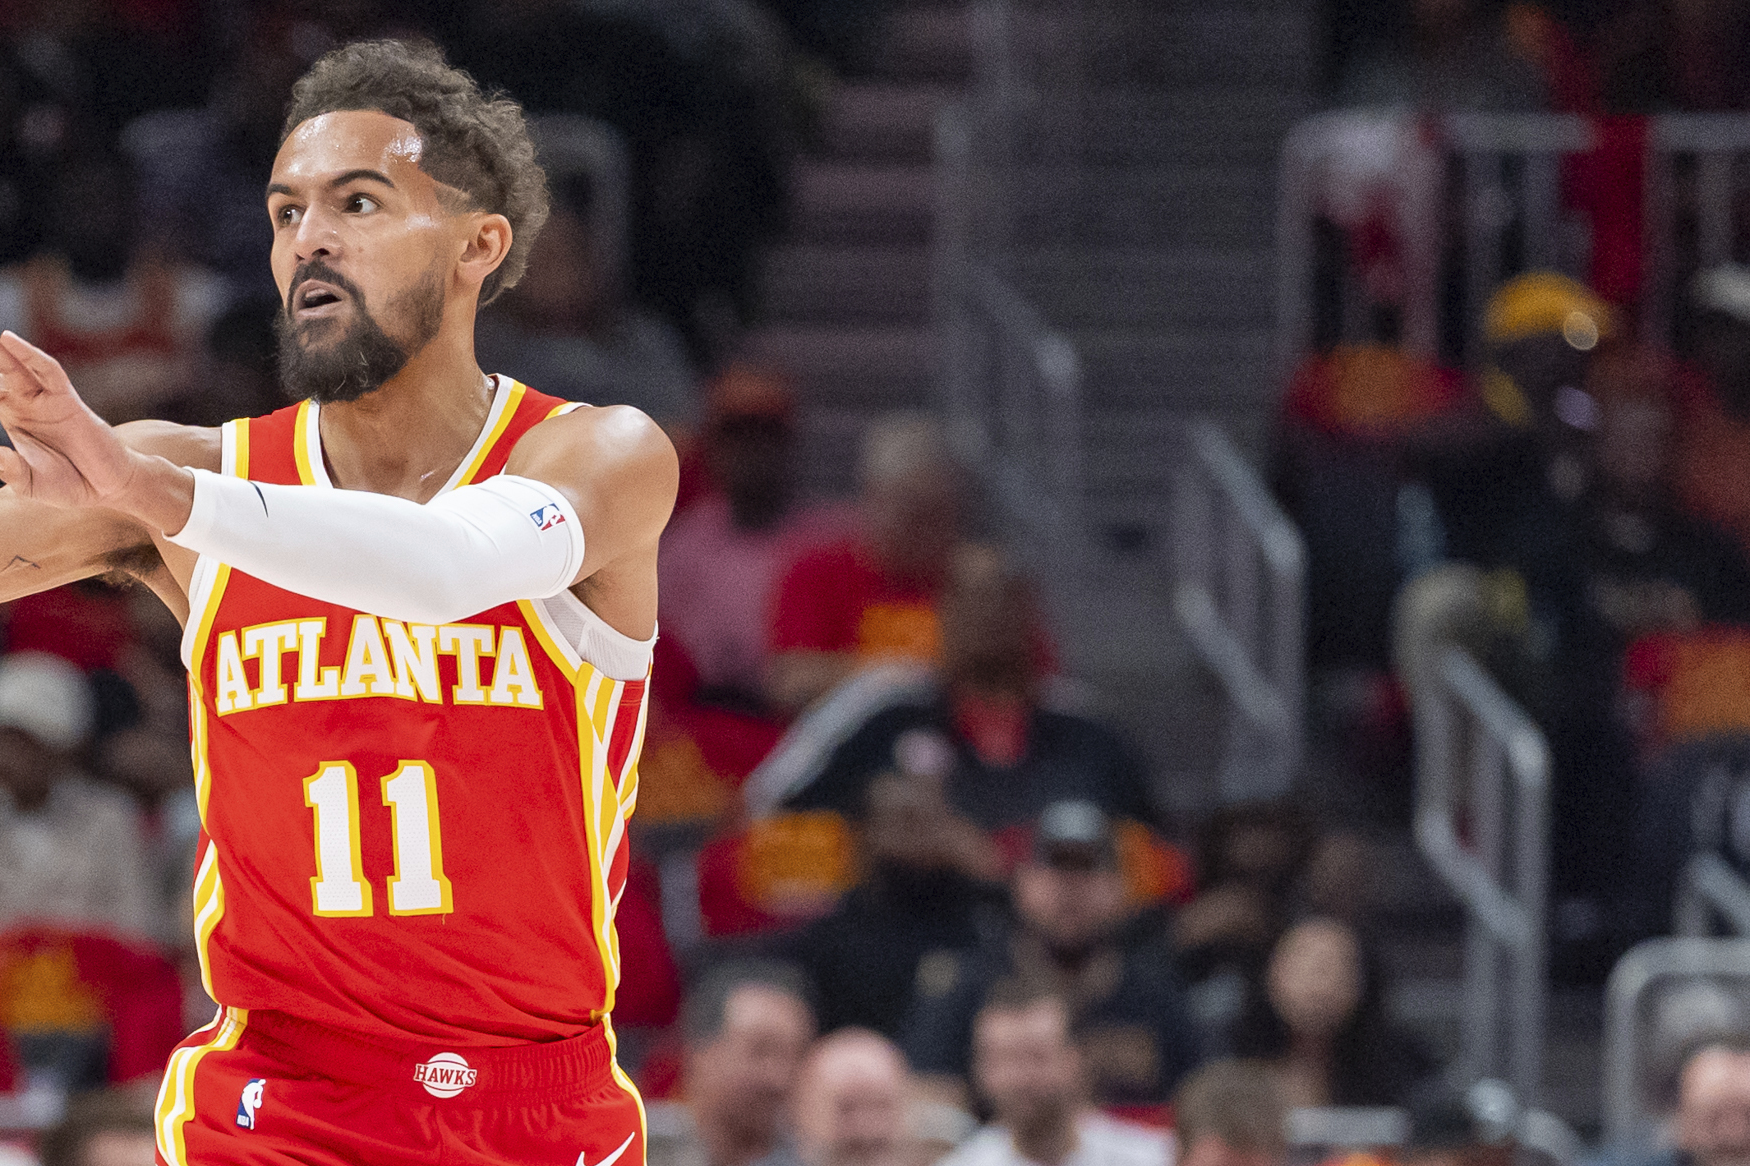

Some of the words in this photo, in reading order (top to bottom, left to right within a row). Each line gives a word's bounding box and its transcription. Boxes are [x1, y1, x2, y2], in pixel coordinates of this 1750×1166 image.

[215, 614, 544, 717] ATLANTA
[302, 759, 454, 918] 11
[414, 1064, 477, 1086] HAWKS
